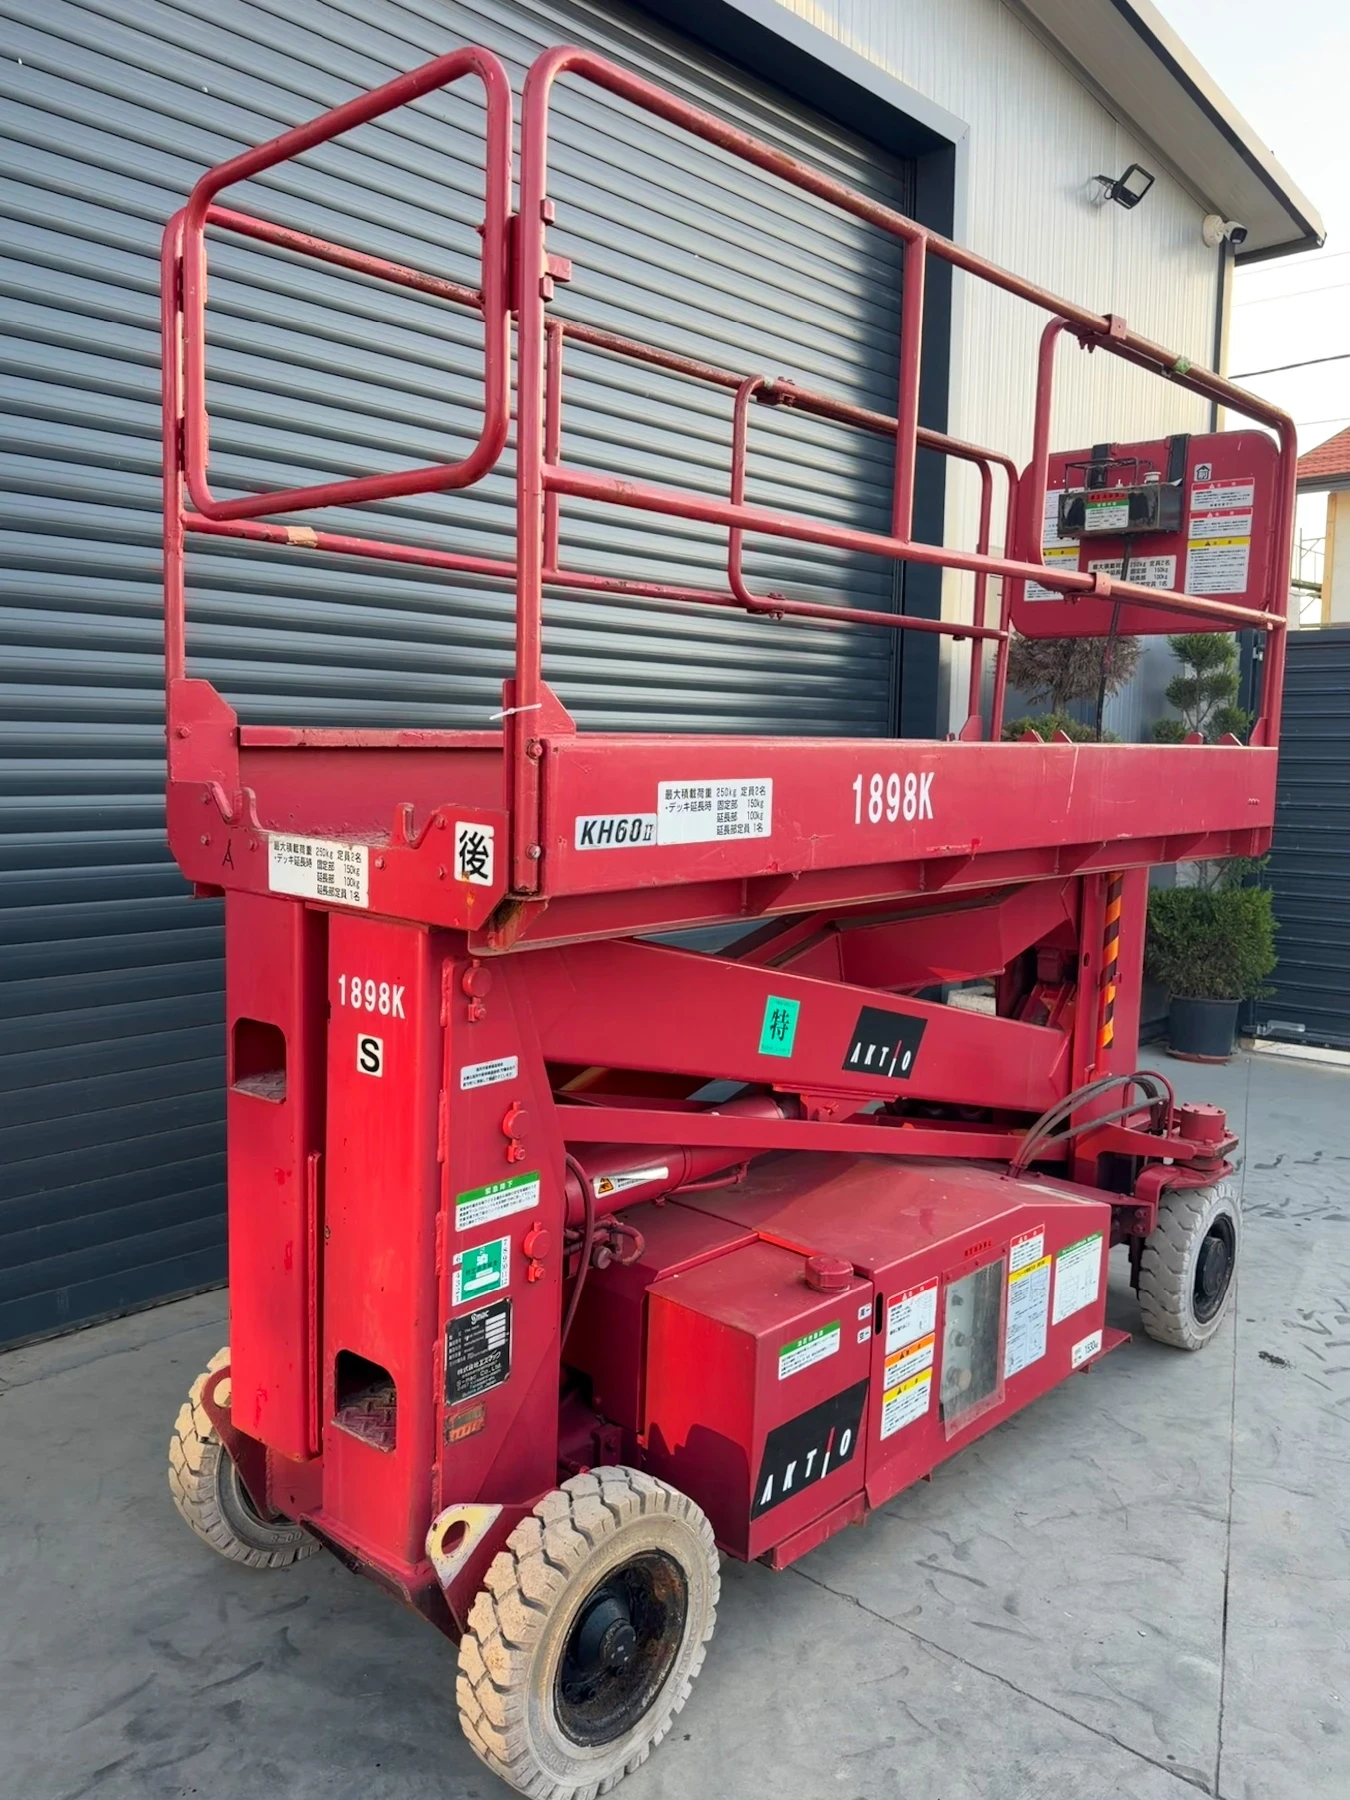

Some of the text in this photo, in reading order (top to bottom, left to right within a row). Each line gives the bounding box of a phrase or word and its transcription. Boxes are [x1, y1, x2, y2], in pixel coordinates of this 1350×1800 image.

[665, 786, 766, 800] 最大積載荷重 250kg 定員2名
[852, 772, 935, 825] 1898K
[717, 800, 738, 811] 固定部
[747, 799, 764, 809] 150kg
[716, 812, 764, 823] 延長部 100kg
[716, 823, 764, 836] 延長部定員 1名
[315, 847, 334, 860] 250kg
[337, 850, 362, 864] 定員2名
[458, 829, 490, 880] 後
[316, 859, 335, 872] 固定部
[343, 864, 360, 877] 150kg
[316, 872, 360, 889] 延長部 100kg
[316, 884, 361, 902] 延長部定員 1名
[338, 973, 406, 1020] 1898K
[770, 1008, 790, 1042] 特
[360, 1038, 380, 1073] S
[850, 1039, 912, 1078] AKTIO
[760, 1426, 852, 1506] AKTIO
